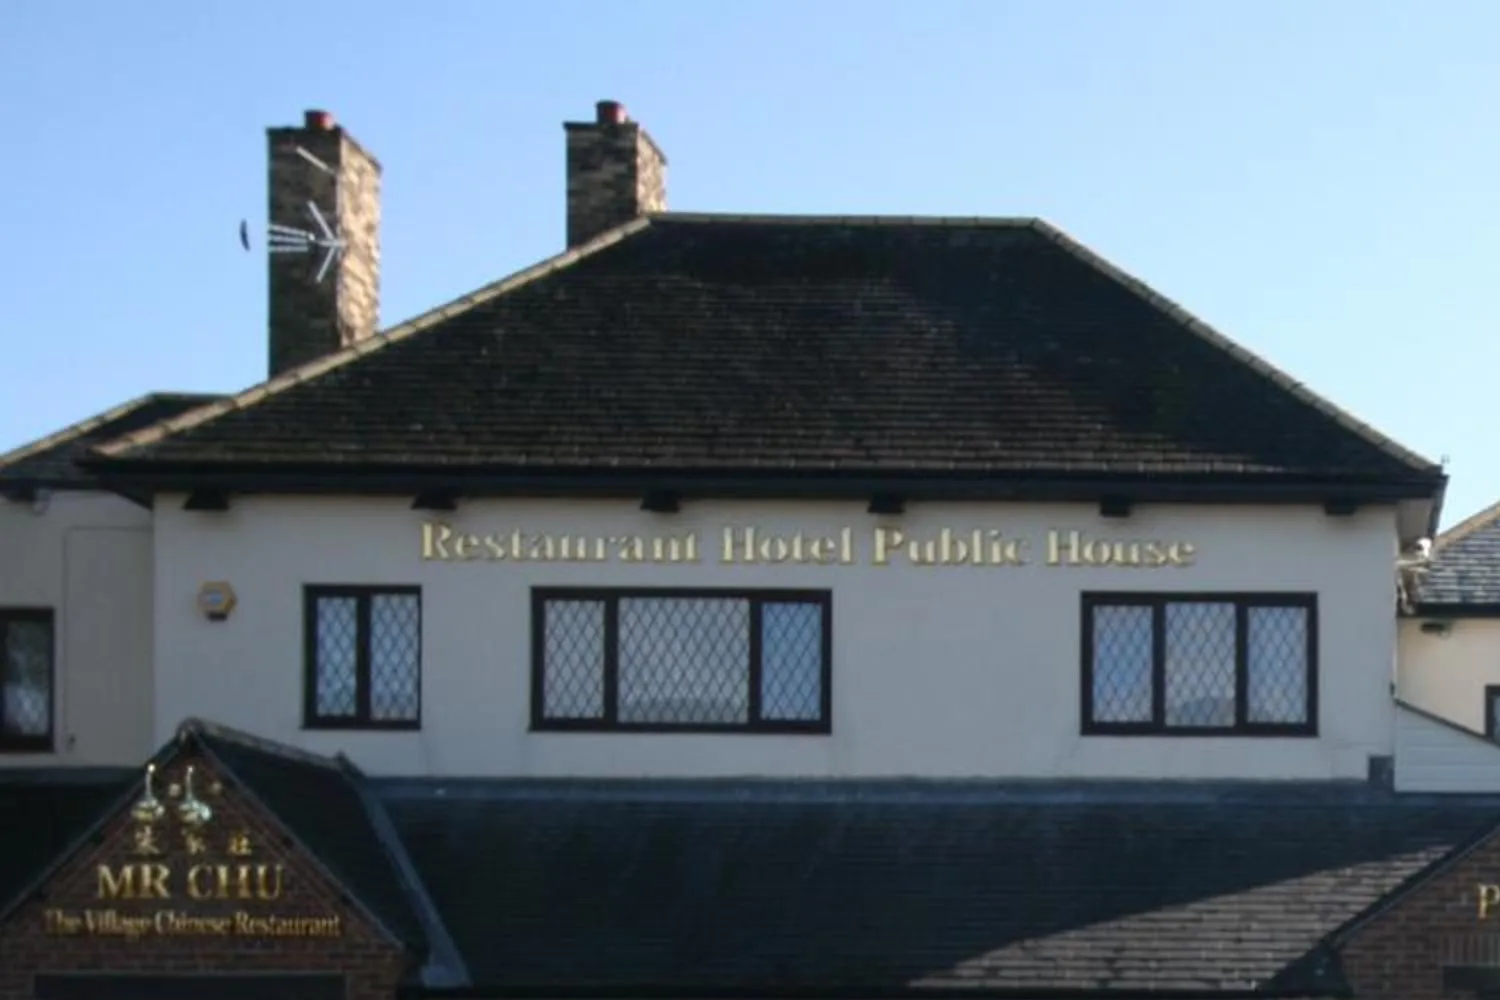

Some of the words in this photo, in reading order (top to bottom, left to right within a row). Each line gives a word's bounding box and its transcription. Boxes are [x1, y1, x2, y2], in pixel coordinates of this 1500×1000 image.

[420, 520, 702, 562] Restaurant
[720, 525, 855, 565] Hotel
[871, 526, 1031, 568] Public
[1046, 528, 1196, 569] House
[96, 863, 172, 899] MR
[186, 863, 284, 899] CHU
[44, 907, 82, 935] The
[84, 907, 152, 940] Village
[154, 907, 233, 936] Chinese
[235, 908, 343, 938] Restaurant
